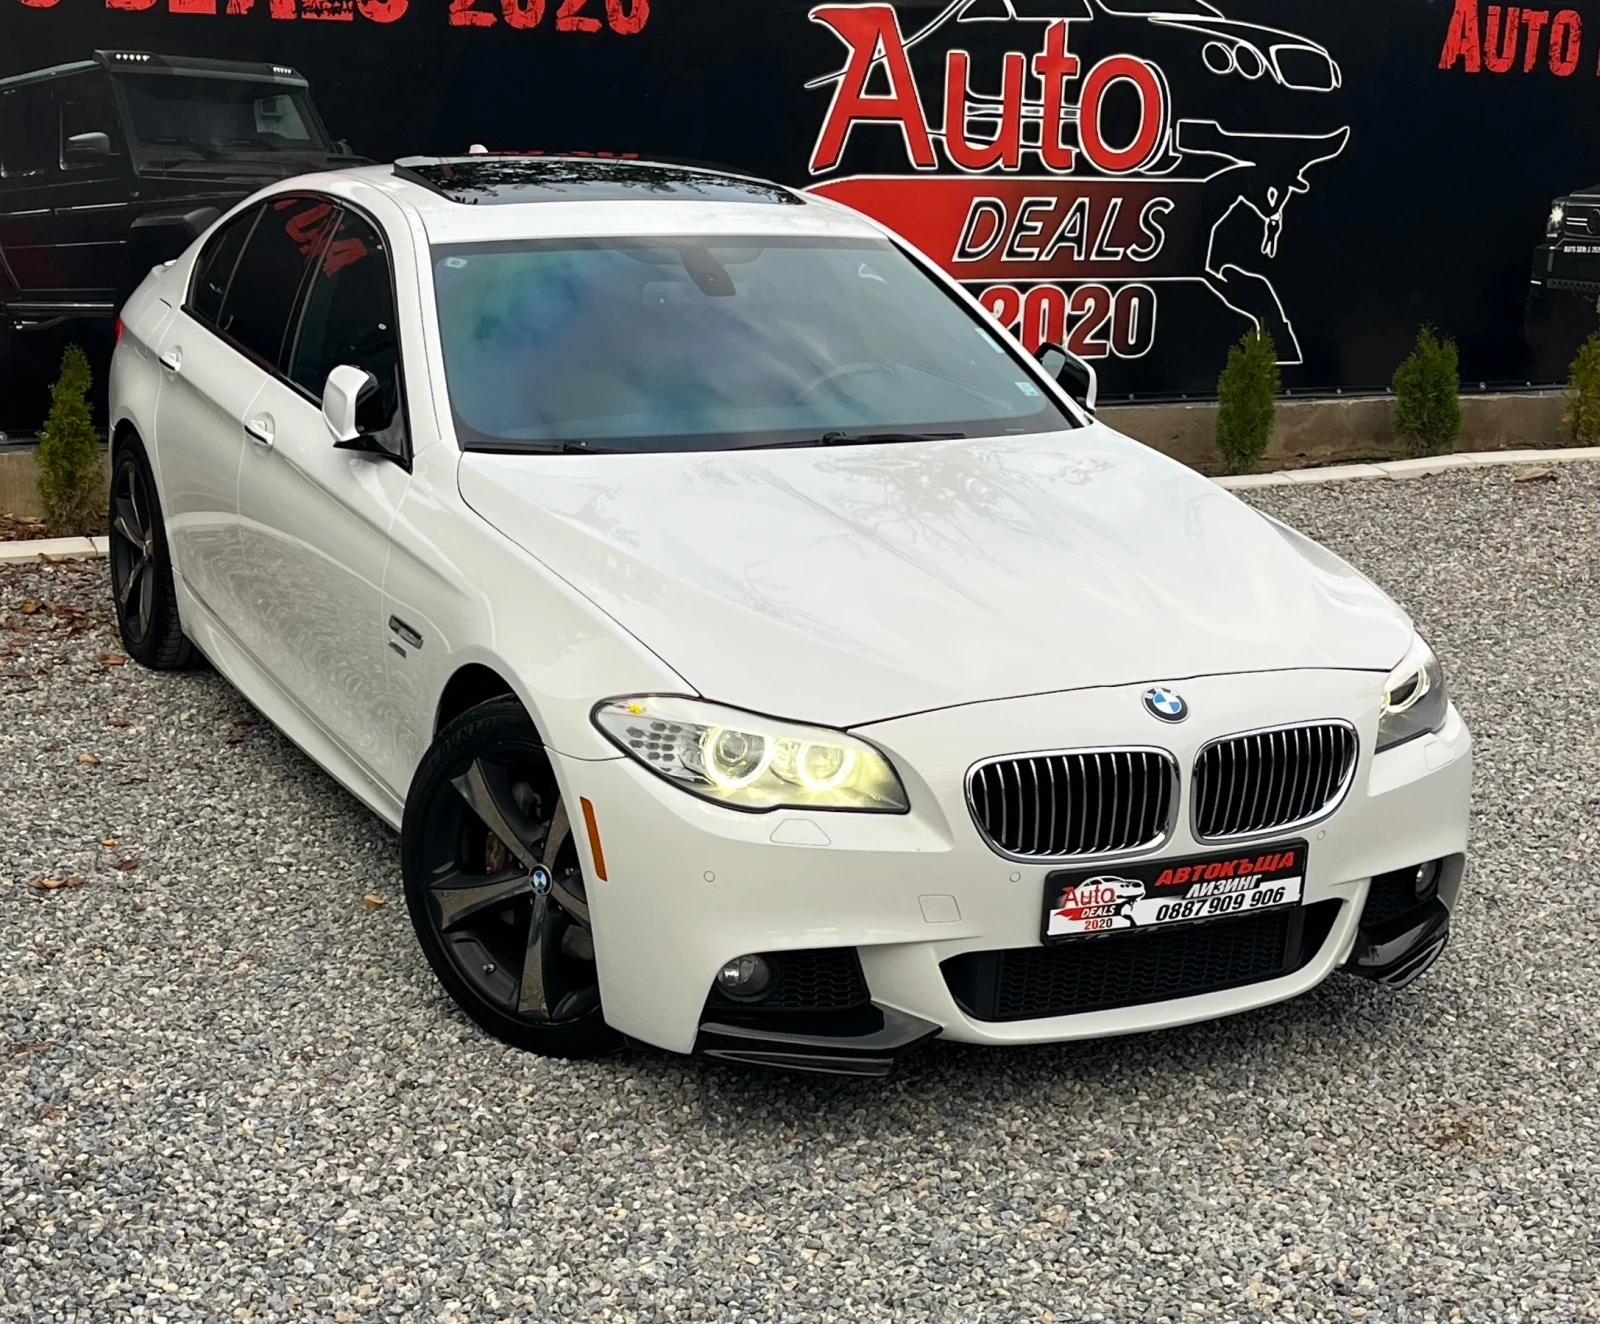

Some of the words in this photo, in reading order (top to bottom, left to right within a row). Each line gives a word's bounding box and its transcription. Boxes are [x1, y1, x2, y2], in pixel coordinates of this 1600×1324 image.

[1438, 0, 1582, 76] AUTO
[807, 3, 1165, 175] Auto
[952, 196, 1175, 262] DEALS
[978, 284, 1158, 359] 2020
[1154, 852, 1295, 886] АВТОКЪЩА
[1062, 885, 1116, 909] Auto
[1155, 900, 1204, 921] 0887
[1207, 893, 1246, 914] 909
[1249, 886, 1286, 907] 906
[1185, 874, 1262, 899] ЛИЗИНГ
[1080, 905, 1116, 918] DEALS
[1084, 918, 1113, 930] 2020
